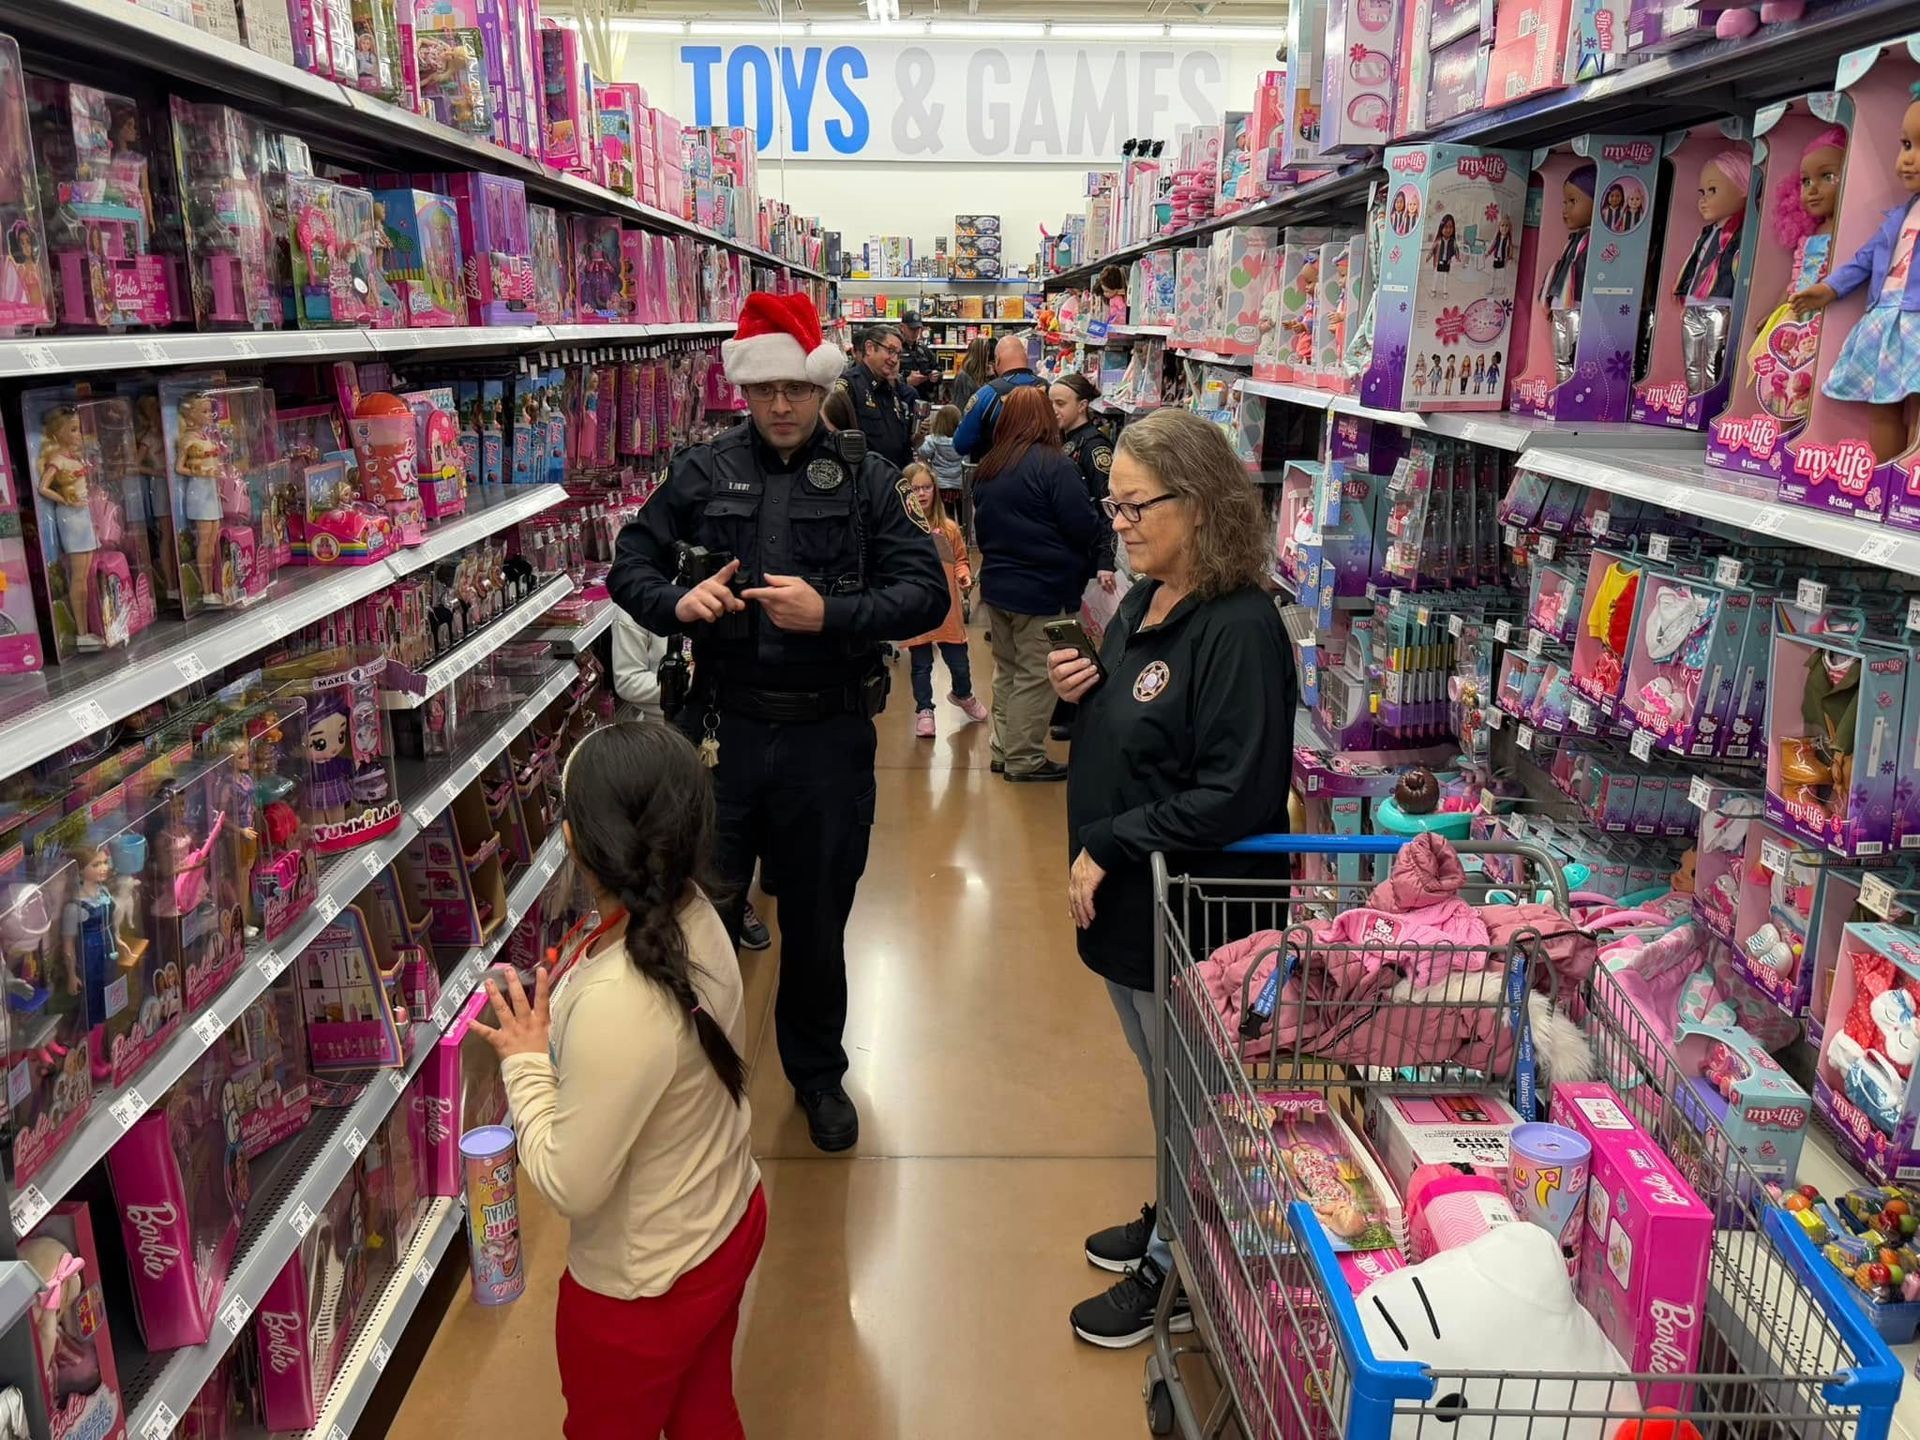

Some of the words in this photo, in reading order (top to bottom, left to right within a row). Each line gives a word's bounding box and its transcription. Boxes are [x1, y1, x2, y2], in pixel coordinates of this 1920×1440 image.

[680, 45, 869, 154] TOYS
[892, 47, 943, 155] &
[966, 48, 1222, 157] GAMES
[1394, 156, 1408, 171] my
[1409, 153, 1426, 168] life
[1460, 159, 1482, 176] my
[1485, 157, 1505, 177] life
[464, 256, 483, 300] Barbie
[1647, 387, 1665, 409] my
[1667, 383, 1686, 408] life
[1720, 422, 1746, 447] my
[1748, 420, 1775, 452] life
[1797, 447, 1833, 480] my
[1835, 444, 1871, 486] life
[1851, 479, 1864, 489] as
[1835, 497, 1854, 510] Chloe
[317, 675, 346, 689] MAKE
[1580, 677, 1592, 693] my
[1592, 679, 1605, 696] life
[1636, 710, 1652, 727] my
[1653, 711, 1669, 731] life
[1786, 799, 1804, 819] my
[1805, 803, 1823, 827] life
[1705, 906, 1718, 924] my
[1718, 911, 1732, 929] life
[1747, 958, 1762, 977] my
[1762, 963, 1778, 985] life
[113, 1022, 147, 1067] Barbie
[1520, 1072, 1530, 1108] Walmart
[1274, 1098, 1327, 1114] Barbie
[1747, 1109, 1776, 1124] my
[1777, 1108, 1803, 1126] life
[1833, 1094, 1851, 1120] my
[1850, 1110, 1870, 1138] life
[16, 1112, 51, 1159] Barbie
[425, 1096, 453, 1147] Barbie
[127, 1201, 181, 1281] Barbie
[261, 1311, 301, 1376] Barbie
[1649, 1300, 1696, 1376] Barbie
[50, 1393, 87, 1439] Barbie
